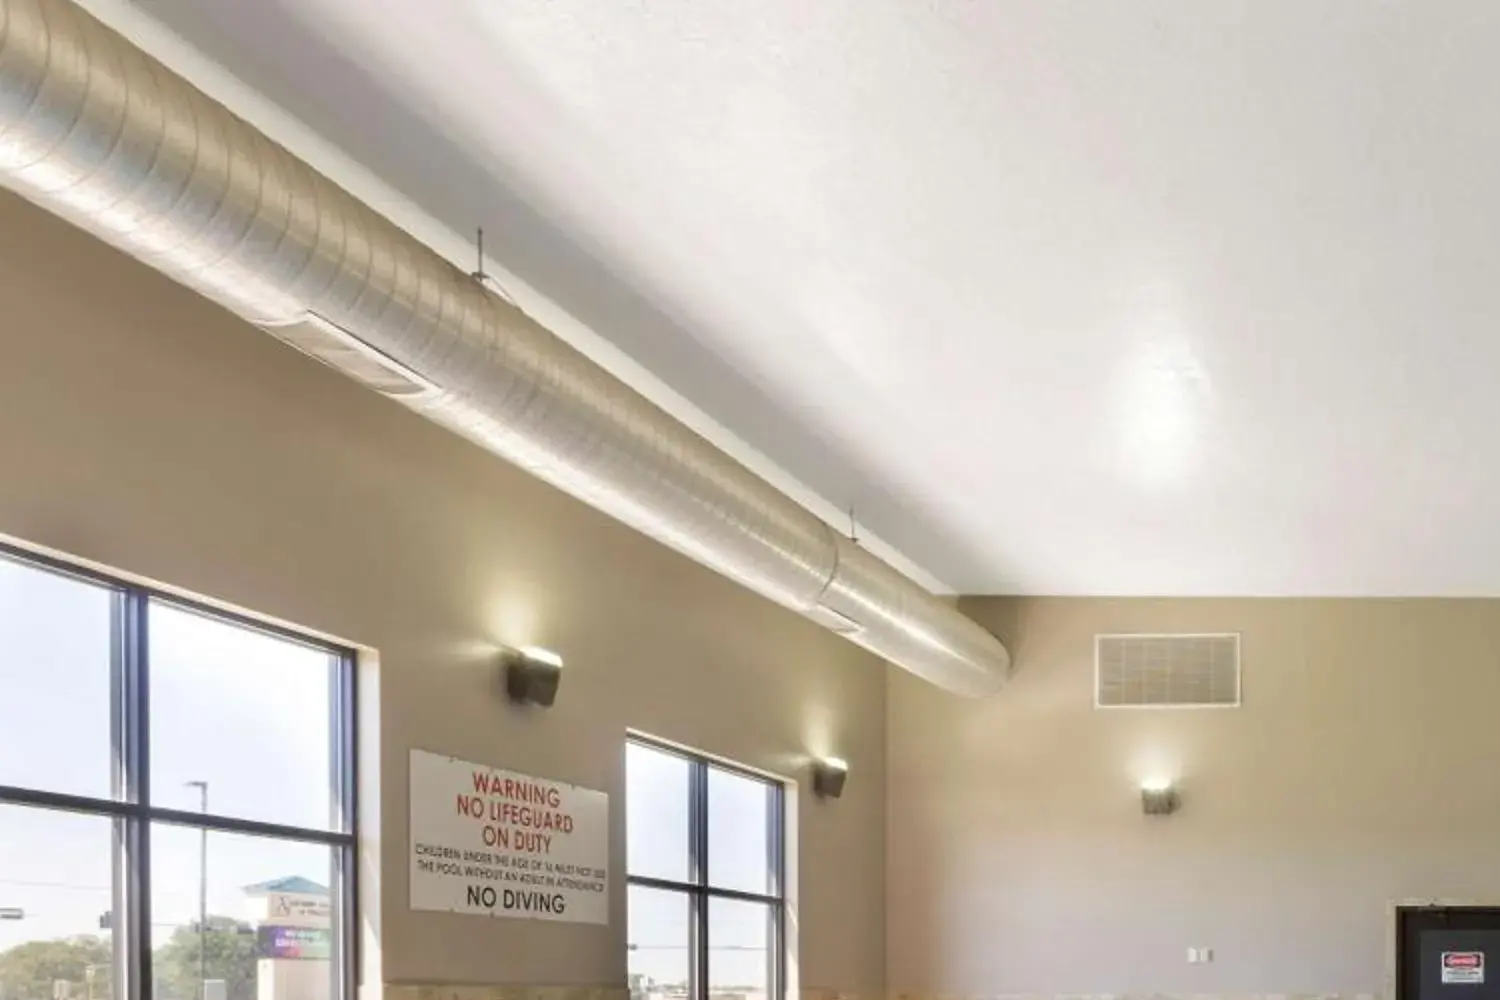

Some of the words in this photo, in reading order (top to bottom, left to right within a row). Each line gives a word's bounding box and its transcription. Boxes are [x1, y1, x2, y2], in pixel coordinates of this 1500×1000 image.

[472, 771, 560, 808] WARNING
[456, 794, 484, 818] NO
[490, 801, 573, 833] LIFEGUARD
[482, 825, 509, 849] ON
[514, 831, 552, 854] DUTY
[436, 861, 462, 876] POOL
[464, 866, 502, 880] WITHOUT
[503, 870, 518, 881] AN
[466, 885, 497, 909] NO
[503, 889, 566, 914] DIVING
